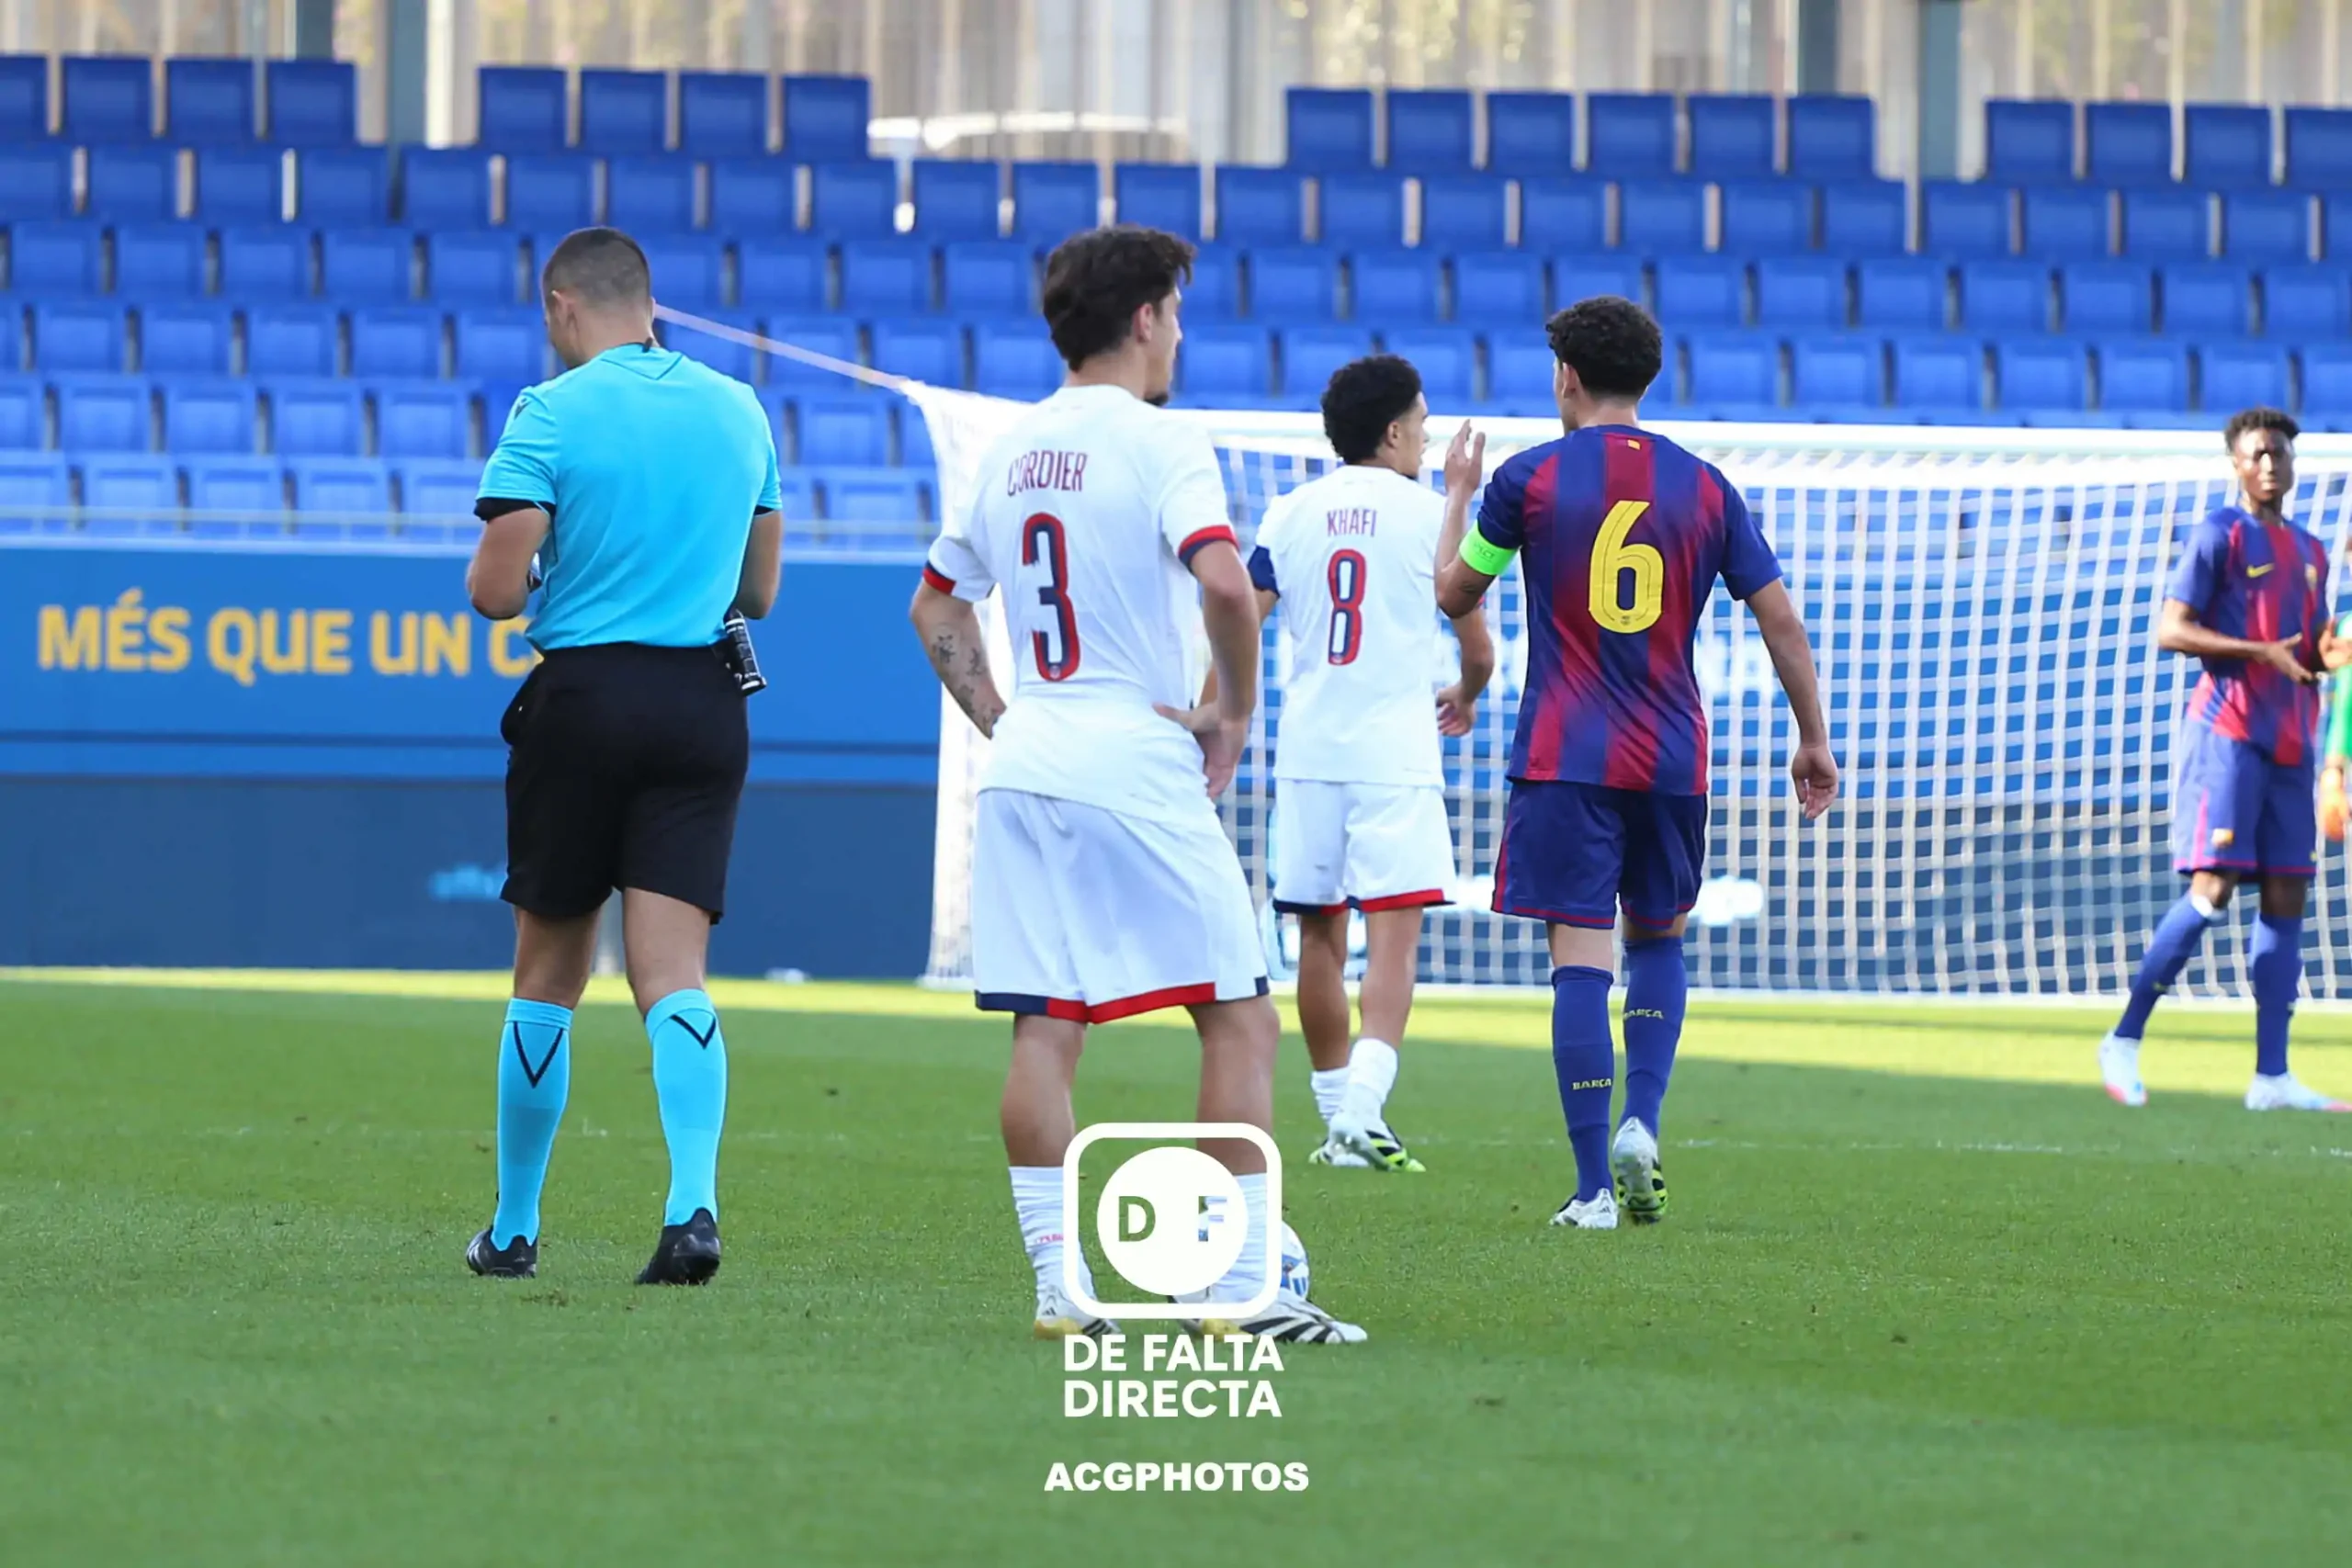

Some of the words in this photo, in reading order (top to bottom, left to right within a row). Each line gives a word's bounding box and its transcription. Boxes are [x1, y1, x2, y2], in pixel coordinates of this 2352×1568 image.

[1007, 450, 1088, 497] CORDIER
[1326, 507, 1378, 537] KHAFI
[1022, 511, 1081, 682] 3
[1327, 548, 1367, 665] 8
[1589, 500, 1664, 634] 6
[38, 586, 193, 671] MÉS
[207, 609, 352, 686] QUE
[369, 611, 470, 676] UN
[489, 617, 545, 677] C
